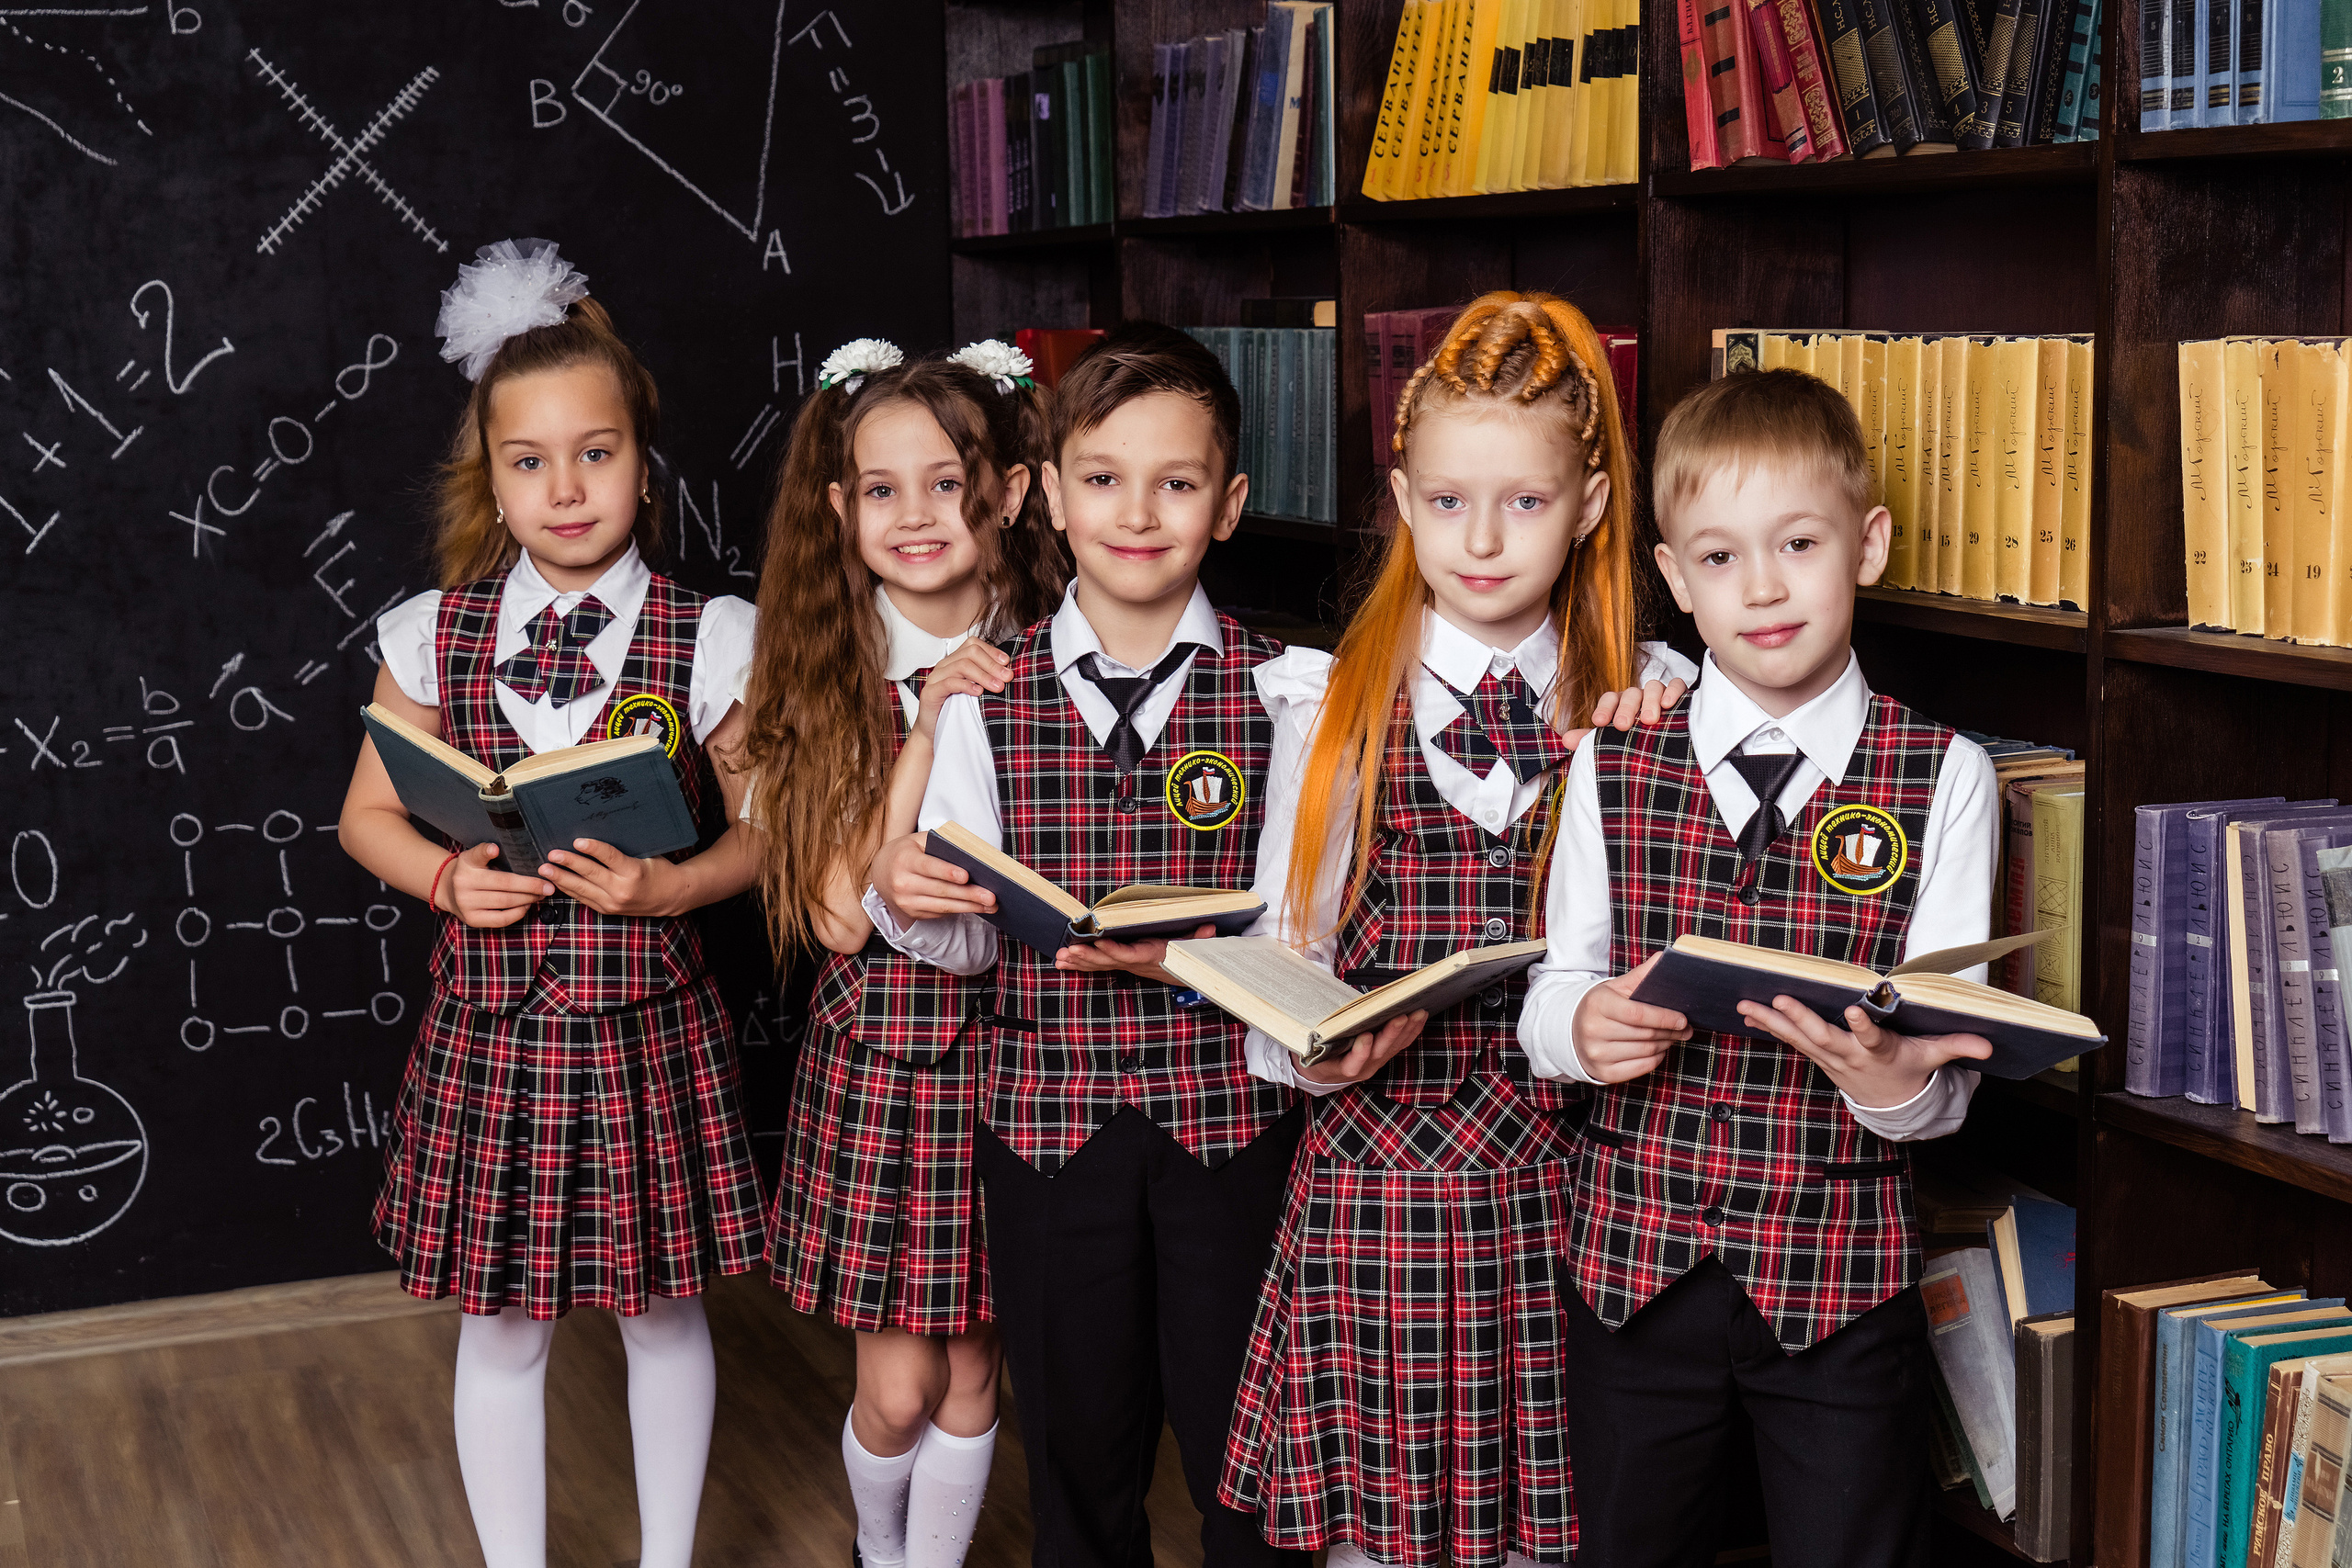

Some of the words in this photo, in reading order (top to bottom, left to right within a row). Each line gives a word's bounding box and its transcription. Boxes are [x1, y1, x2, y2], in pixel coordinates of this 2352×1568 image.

[2332, 66, 2344, 84] 2
[1981, 101, 1988, 114] 3
[2006, 101, 2013, 114] 5
[1892, 524, 1904, 538] 13
[1921, 528, 1933, 542] 14
[1969, 531, 1980, 545] 29
[2040, 529, 2053, 544] 25
[1940, 535, 1951, 548] 15
[2005, 535, 2019, 549] 28
[2064, 537, 2076, 551] 26
[2193, 550, 2207, 565] 22
[2240, 559, 2253, 574] 23
[2266, 561, 2279, 577] 24
[2304, 564, 2322, 580] 19
[2136, 840, 2154, 928] ЛЬЮИС
[2190, 844, 2207, 931] ЛЬЮИС
[2271, 863, 2298, 953] ЛЬЮИС
[2304, 868, 2331, 959] ЛЬЮИС
[2196, 936, 2200, 944] 2
[2128, 949, 2151, 1066] СИНКЛЕР
[2188, 955, 2206, 1072] СИНКЛЕР
[2284, 980, 2311, 1102] СИНКЛЕР
[2317, 987, 2343, 1110] СИНКЛЕР
[2224, 1419, 2234, 1470] ОНТАРИО
[2261, 1432, 2274, 1483] ПРАВО
[2223, 1472, 2233, 1513] БЕРЕГАХ
[2222, 1514, 2230, 1529] НА
